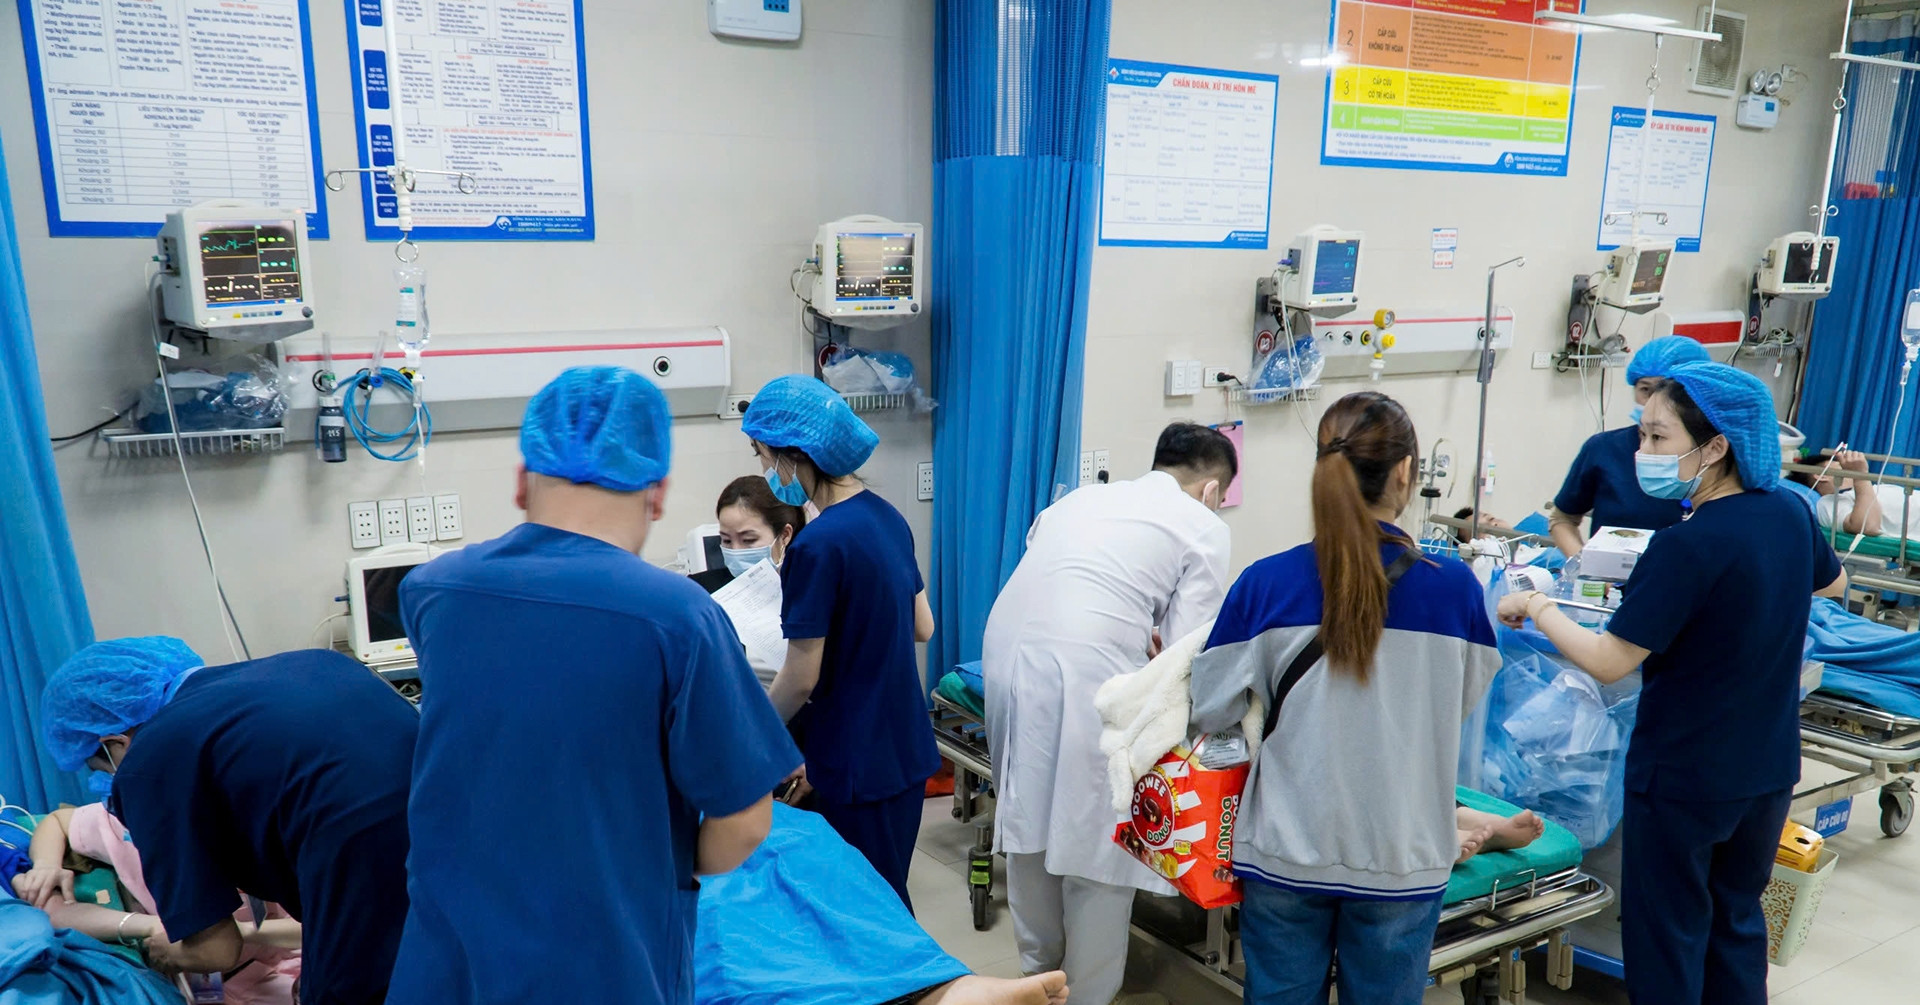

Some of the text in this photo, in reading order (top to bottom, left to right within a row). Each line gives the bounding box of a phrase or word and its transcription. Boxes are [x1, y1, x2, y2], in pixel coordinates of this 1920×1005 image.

[1346, 30, 1354, 46] 2
[1378, 26, 1387, 37] CẤP
[1368, 41, 1384, 51] KHÔNG
[1172, 77, 1190, 88] CHẨN
[1212, 80, 1222, 90] XỬ
[1223, 82, 1232, 92] TRÍ
[1233, 83, 1246, 92] HÔN
[1247, 84, 1256, 94] MÊ
[1344, 80, 1350, 96] 3
[1372, 75, 1382, 85] CẤP
[1340, 112, 1346, 124] 4
[1132, 776, 1166, 816] DOOWEE
[1147, 815, 1171, 842] DONUT
[1217, 796, 1232, 862] DONUT
[1818, 812, 1840, 832] CẤP CỨU
